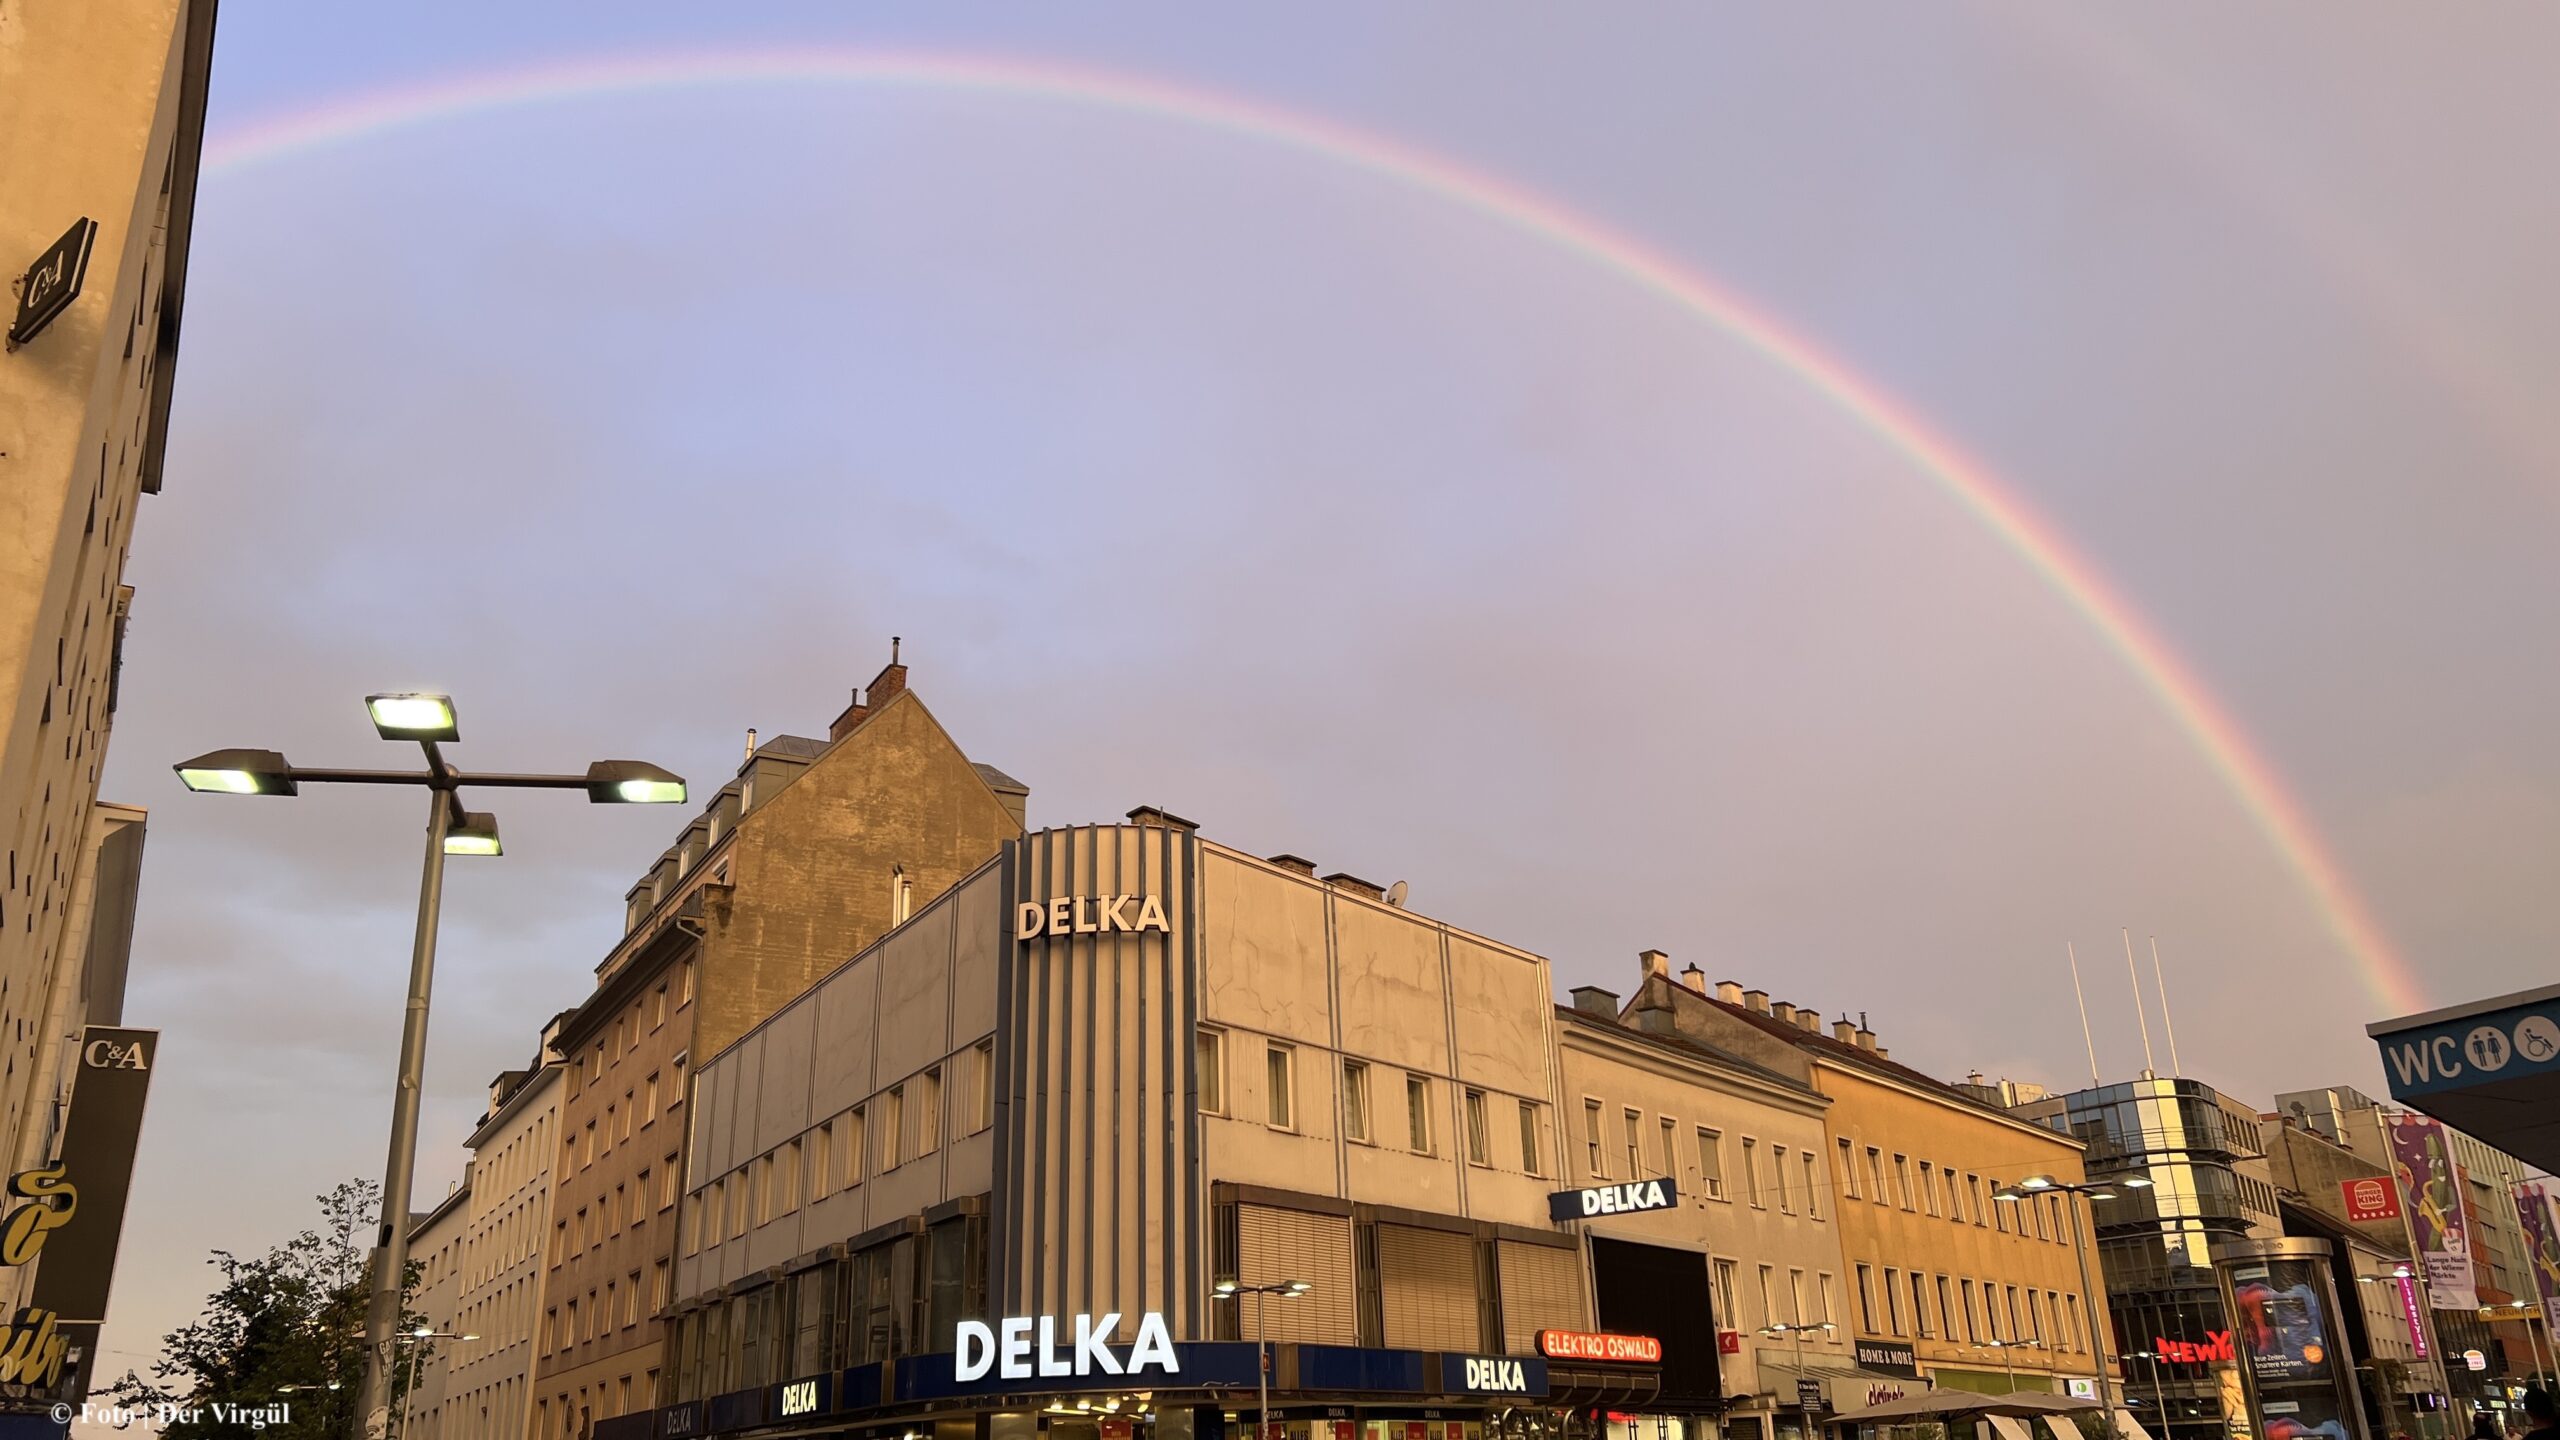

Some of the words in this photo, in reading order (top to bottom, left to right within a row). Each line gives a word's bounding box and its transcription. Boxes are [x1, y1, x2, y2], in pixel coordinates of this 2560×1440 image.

[28, 250, 63, 308] C&A
[1017, 893, 1171, 941] DELKA
[85, 1040, 147, 1070] C&A
[2388, 1036, 2462, 1086] WC
[1582, 1181, 1667, 1216] DELKA
[2356, 1189, 2382, 1197] BURGER
[2358, 1195, 2383, 1204] KING
[955, 1312, 1180, 1382] DELKA
[1547, 1333, 1604, 1356] ELEKTRO
[1607, 1337, 1657, 1360] OSWALD
[1859, 1348, 1885, 1364] HOME
[1884, 1350, 1891, 1364] &
[1890, 1350, 1914, 1366] MORE
[1466, 1359, 1526, 1392] DELKA
[782, 1381, 816, 1416] DELKA
[1328, 1408, 1346, 1417] DELKA
[667, 1408, 691, 1435] DELKA
[1267, 1410, 1284, 1420] ELKA
